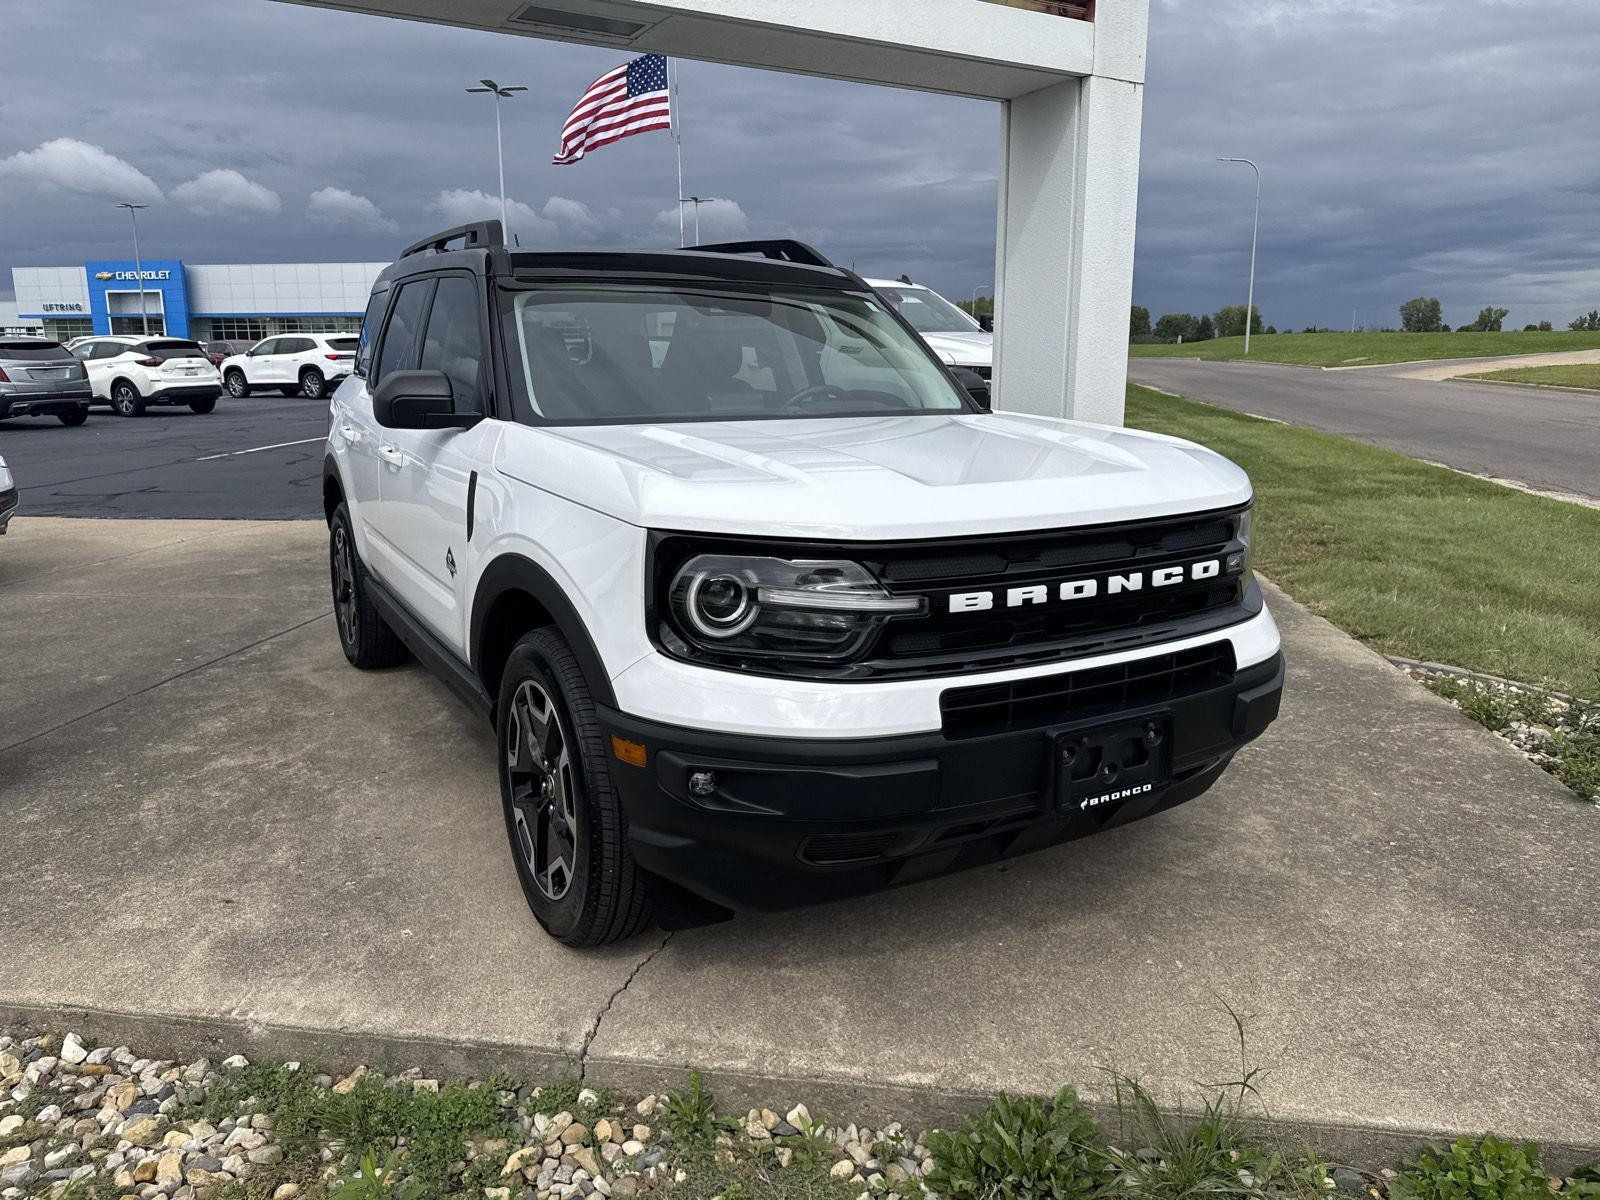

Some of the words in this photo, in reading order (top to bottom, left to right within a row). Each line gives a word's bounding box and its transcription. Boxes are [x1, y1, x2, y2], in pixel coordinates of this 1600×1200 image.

[115, 270, 170, 280] CHEVROLET
[42, 303, 82, 312] UFTRING
[949, 559, 1220, 613] BRONCO
[1089, 783, 1152, 806] BRONCO
